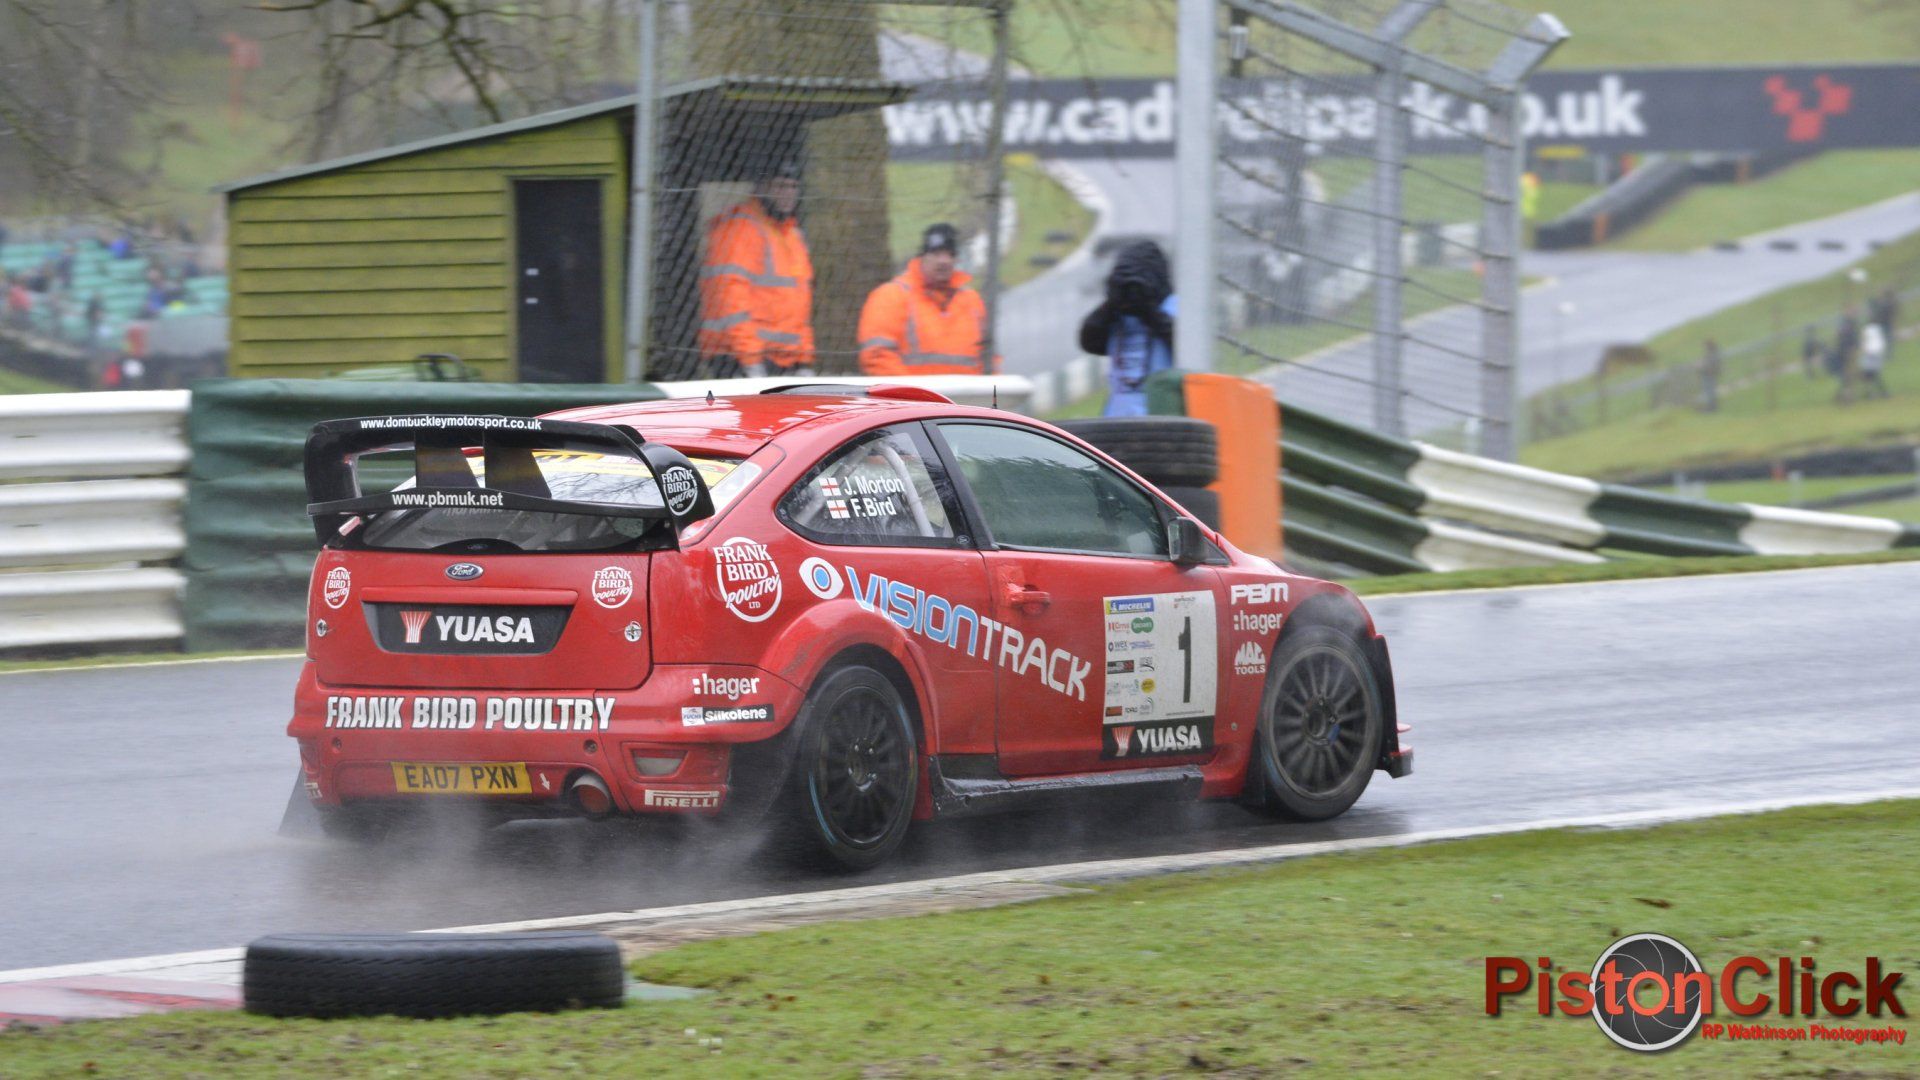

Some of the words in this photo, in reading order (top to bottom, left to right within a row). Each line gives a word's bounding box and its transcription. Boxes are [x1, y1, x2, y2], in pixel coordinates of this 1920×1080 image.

[359, 416, 542, 430] www.dombuckleymotorsport.co.uk
[661, 469, 695, 484] FRANK
[855, 476, 905, 494] Morton
[667, 480, 690, 493] BIRD
[391, 490, 504, 508] www.pbmuk.net
[712, 544, 773, 564] FRANK
[327, 570, 351, 580] FRANK
[594, 570, 632, 580] FRANK
[725, 562, 769, 581] BIRD
[328, 579, 347, 589] BIRD
[598, 579, 626, 589] BIRD
[725, 573, 780, 609] POULTRY
[1230, 582, 1288, 605] PBM
[748, 601, 761, 609] LTD
[435, 615, 536, 643] YUASA
[1178, 616, 1191, 703] 1
[1234, 665, 1266, 675] TOOLS
[324, 696, 405, 728] FRANK
[410, 696, 479, 729] BIRD
[484, 697, 616, 731] POULTRY
[704, 708, 768, 722] Silkolene
[1136, 725, 1202, 753] YUASA
[403, 765, 460, 789] EA07
[470, 766, 518, 789] PXN
[644, 789, 721, 808] PIRELLI
